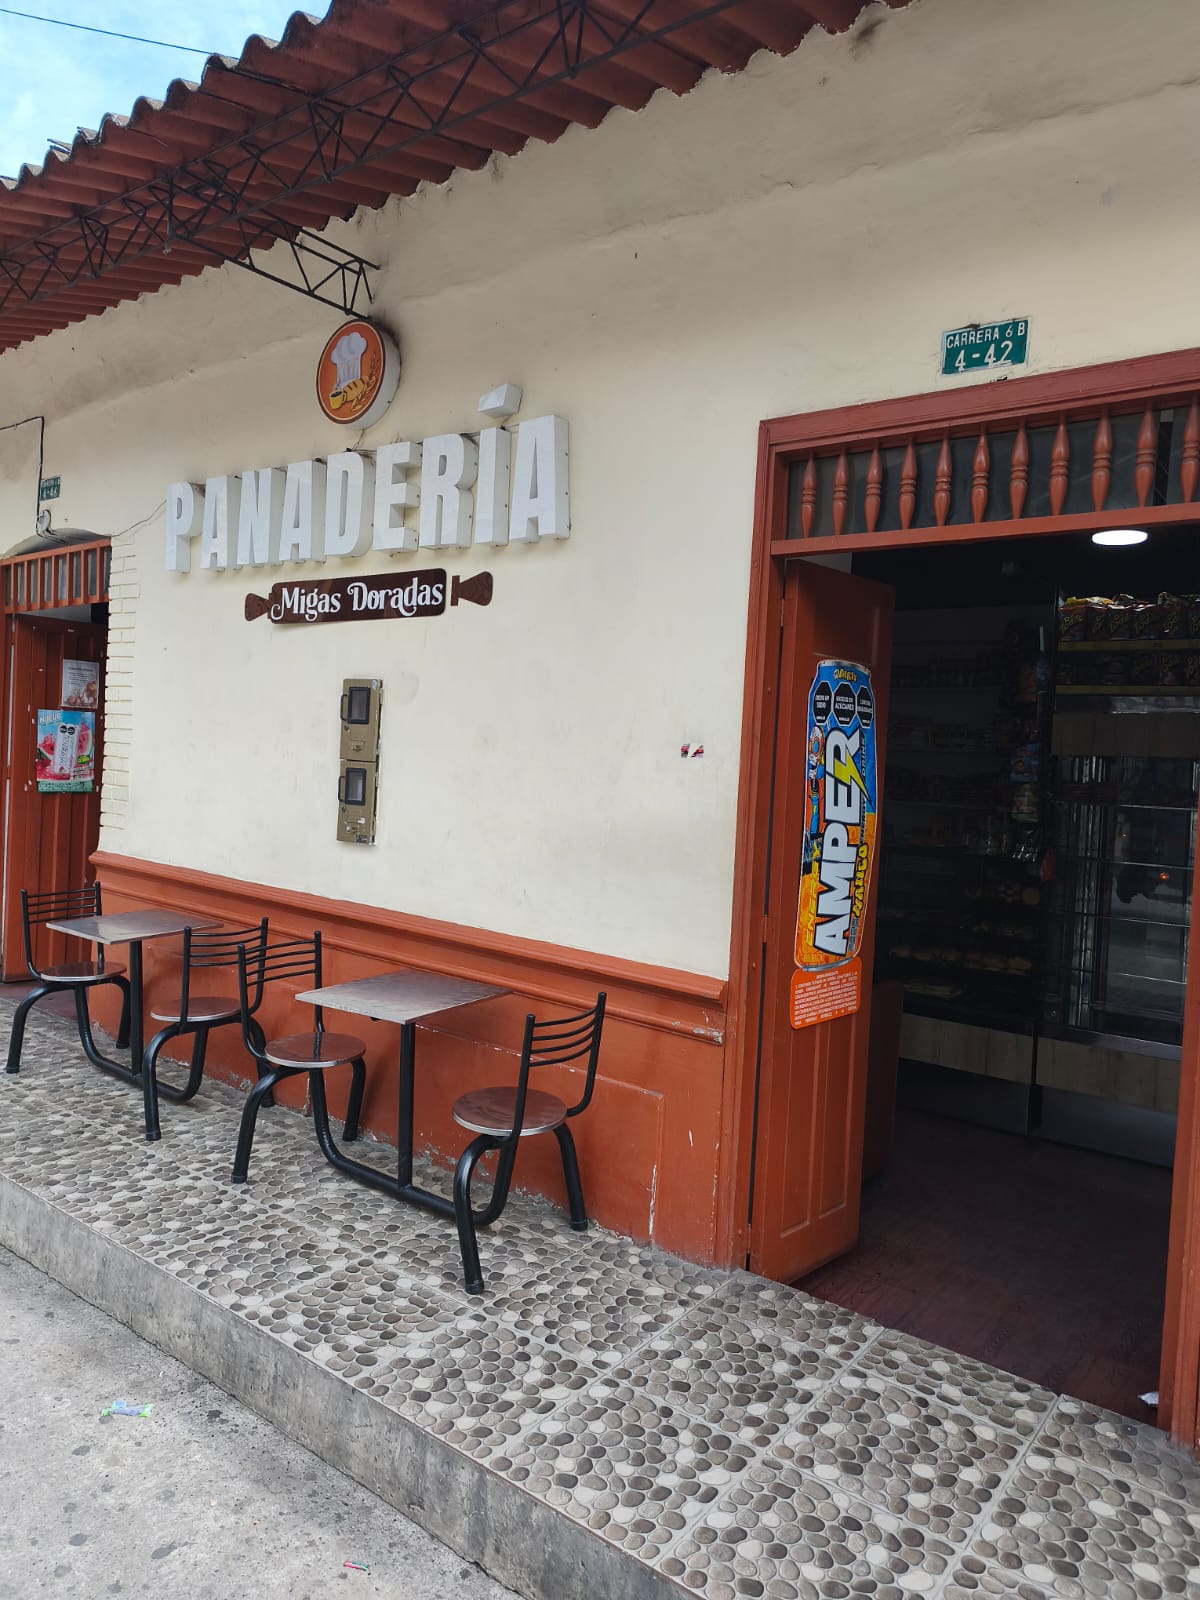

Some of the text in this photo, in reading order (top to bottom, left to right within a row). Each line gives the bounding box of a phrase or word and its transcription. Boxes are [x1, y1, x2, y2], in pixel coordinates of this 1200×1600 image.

[946, 327, 1000, 349] CARRERA
[165, 384, 570, 573] PANADERÍA
[270, 577, 444, 622] Migas Doradas
[805, 841, 821, 946] ENERGY
[813, 729, 862, 957] AMPER
